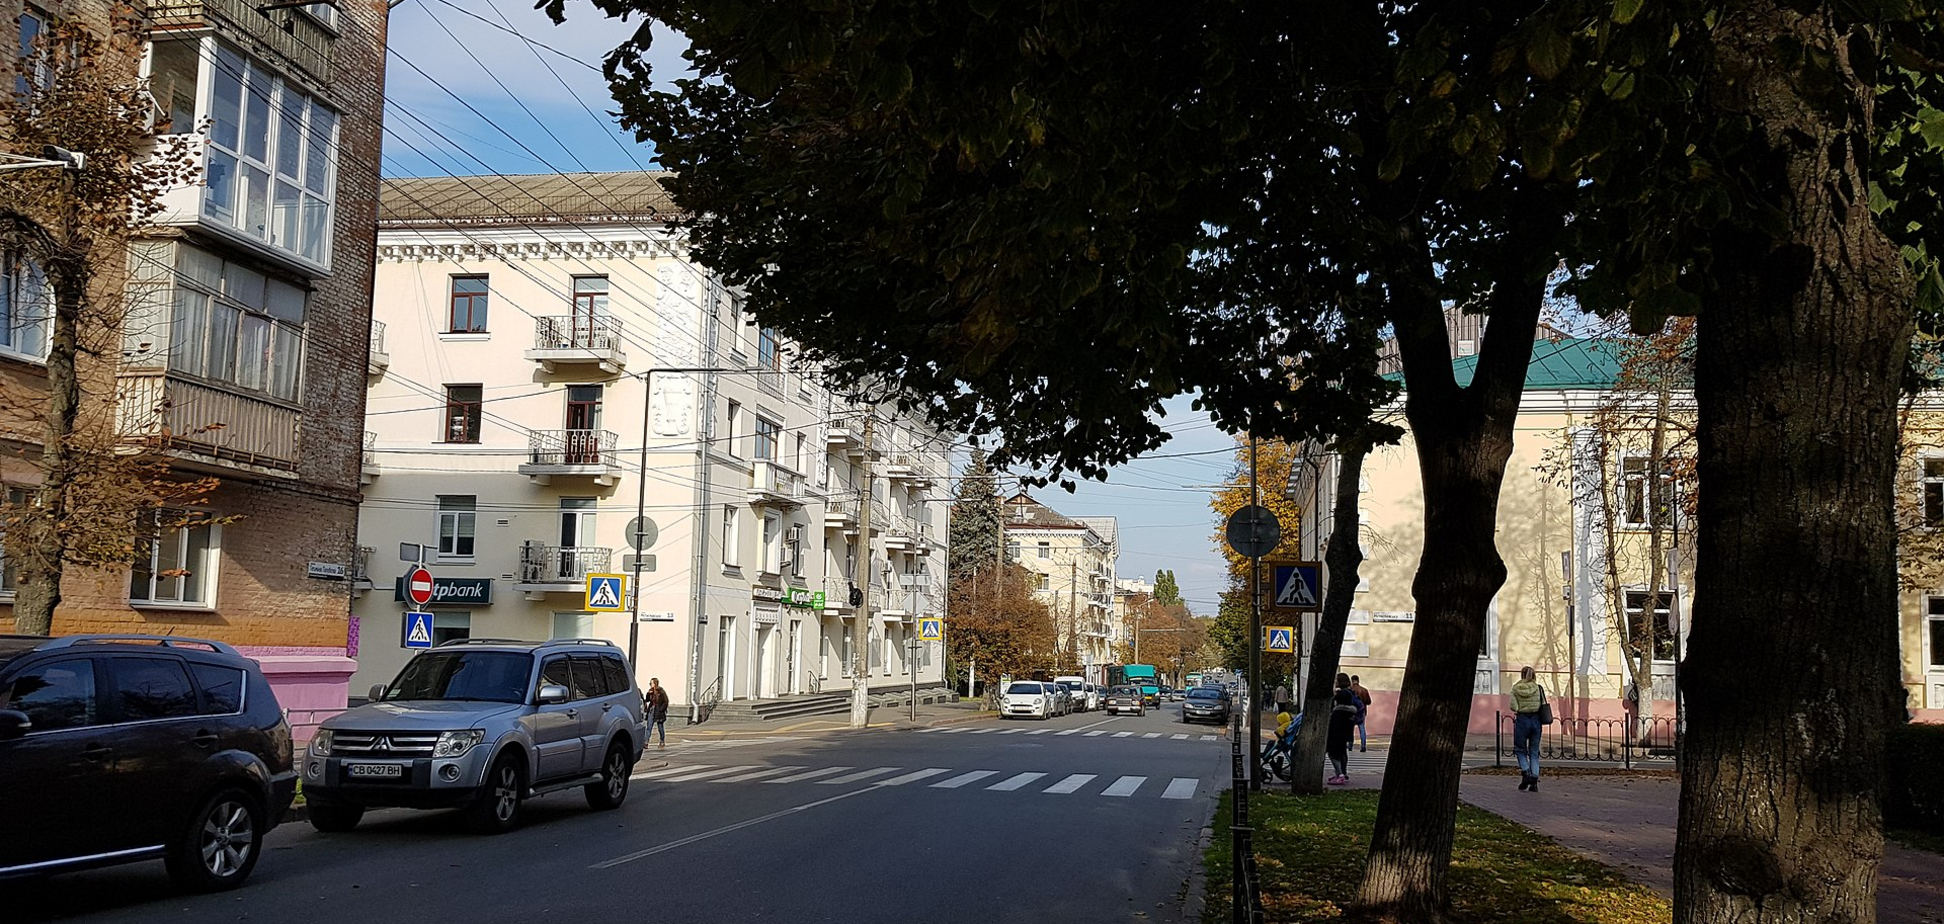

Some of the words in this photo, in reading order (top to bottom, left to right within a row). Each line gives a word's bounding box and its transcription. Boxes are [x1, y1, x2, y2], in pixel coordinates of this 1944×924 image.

[432, 582, 483, 600] tpbank
[353, 765, 365, 775] CB
[367, 765, 386, 775] 0427
